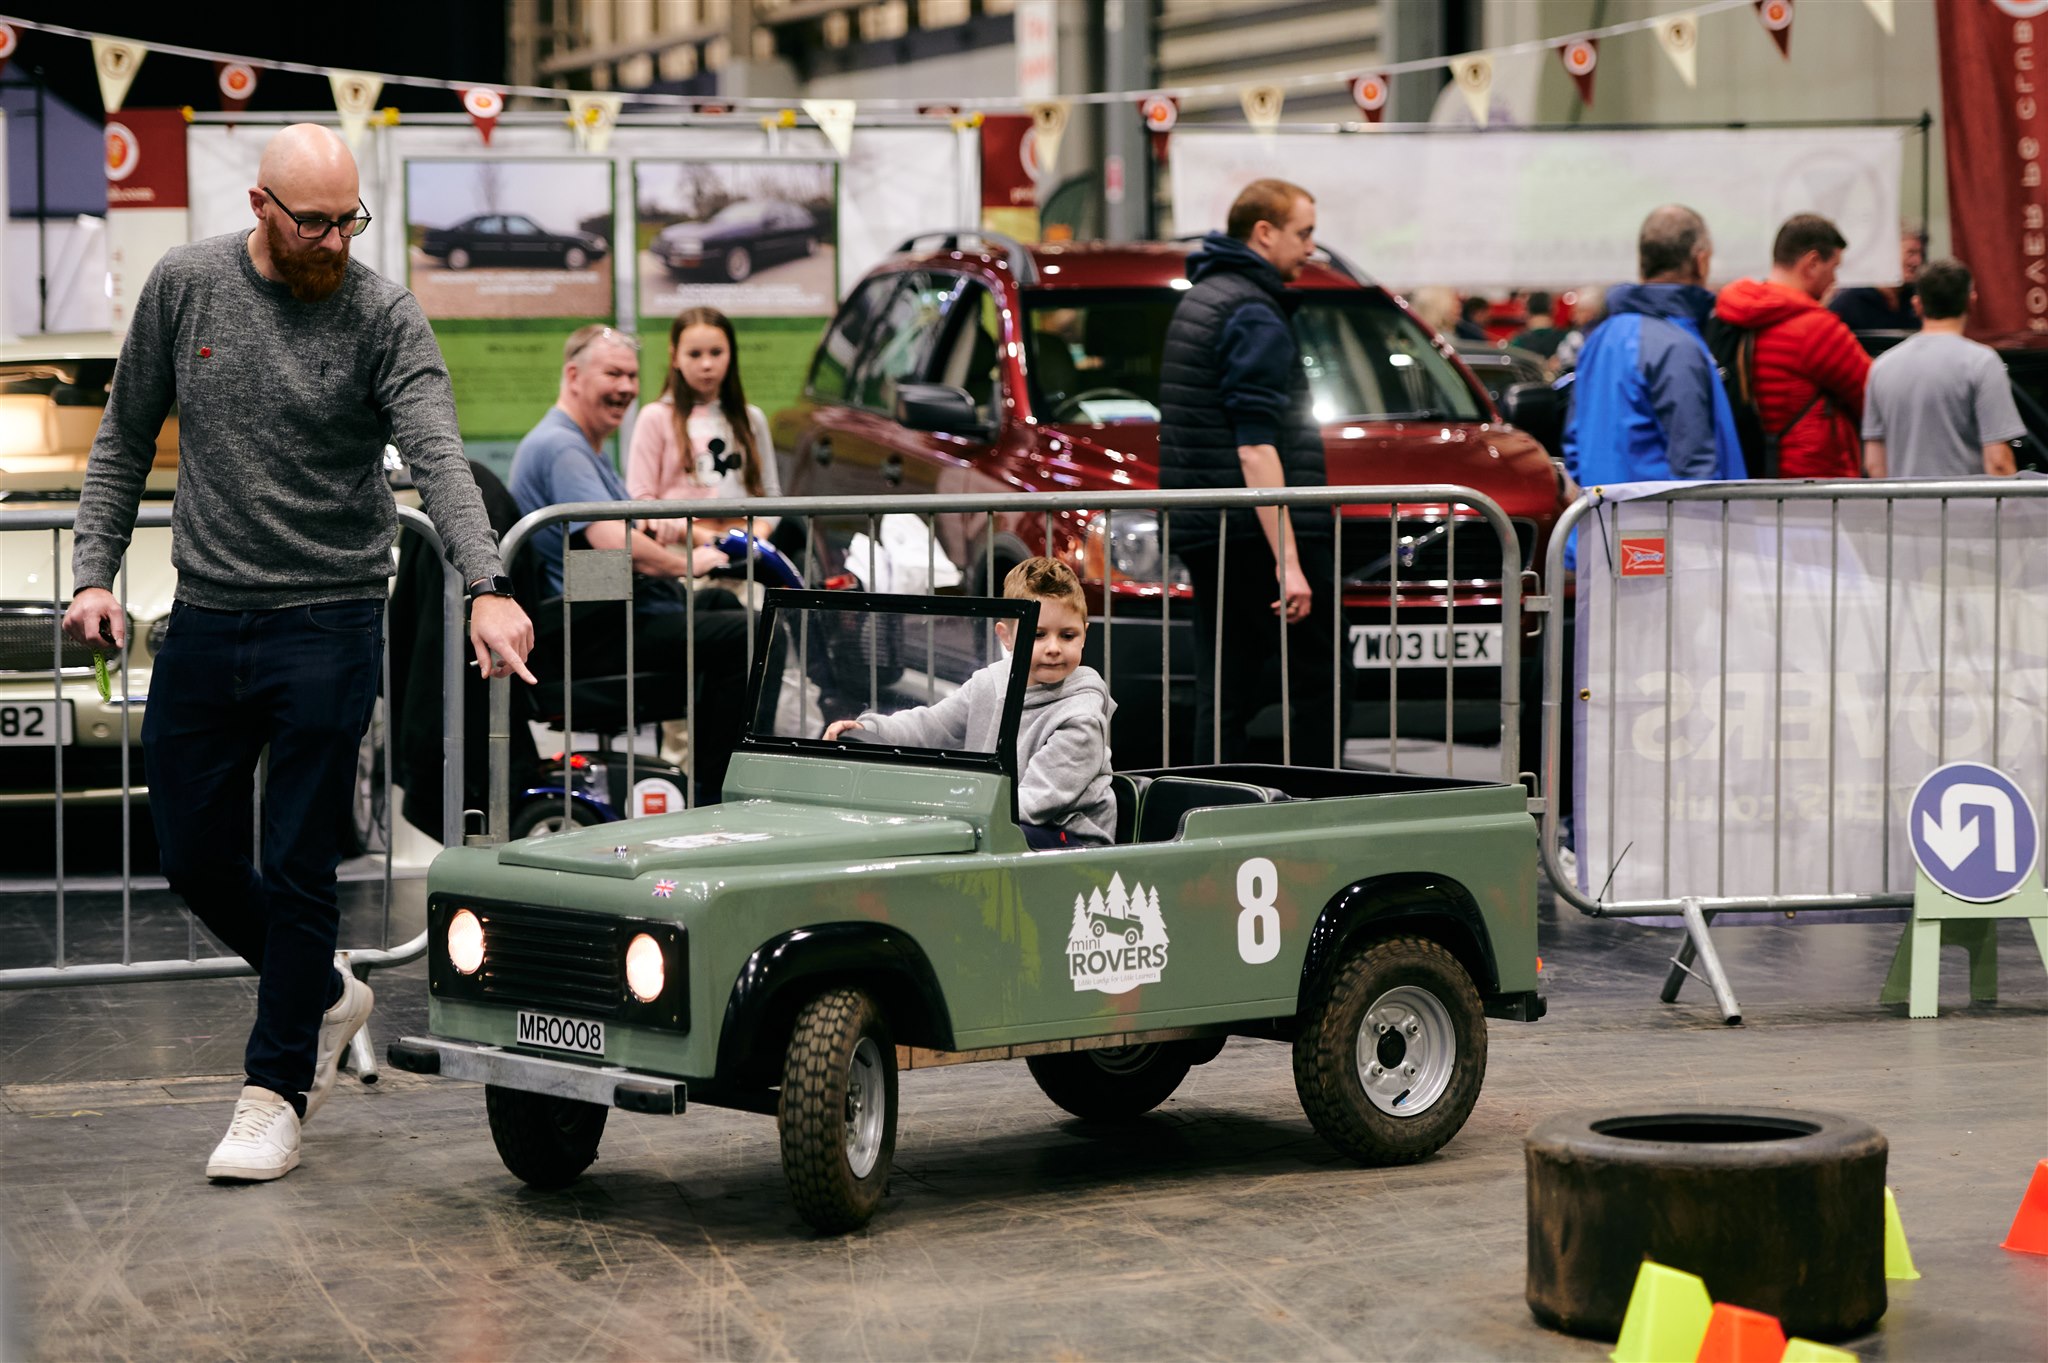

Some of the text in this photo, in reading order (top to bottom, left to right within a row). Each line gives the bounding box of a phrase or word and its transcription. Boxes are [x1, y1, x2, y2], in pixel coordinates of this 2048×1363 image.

[1433, 632, 1489, 659] UEX
[1, 706, 44, 737] 82
[1236, 857, 1281, 965] 8
[1071, 935, 1101, 952] mini
[1071, 943, 1166, 977] ROVERS
